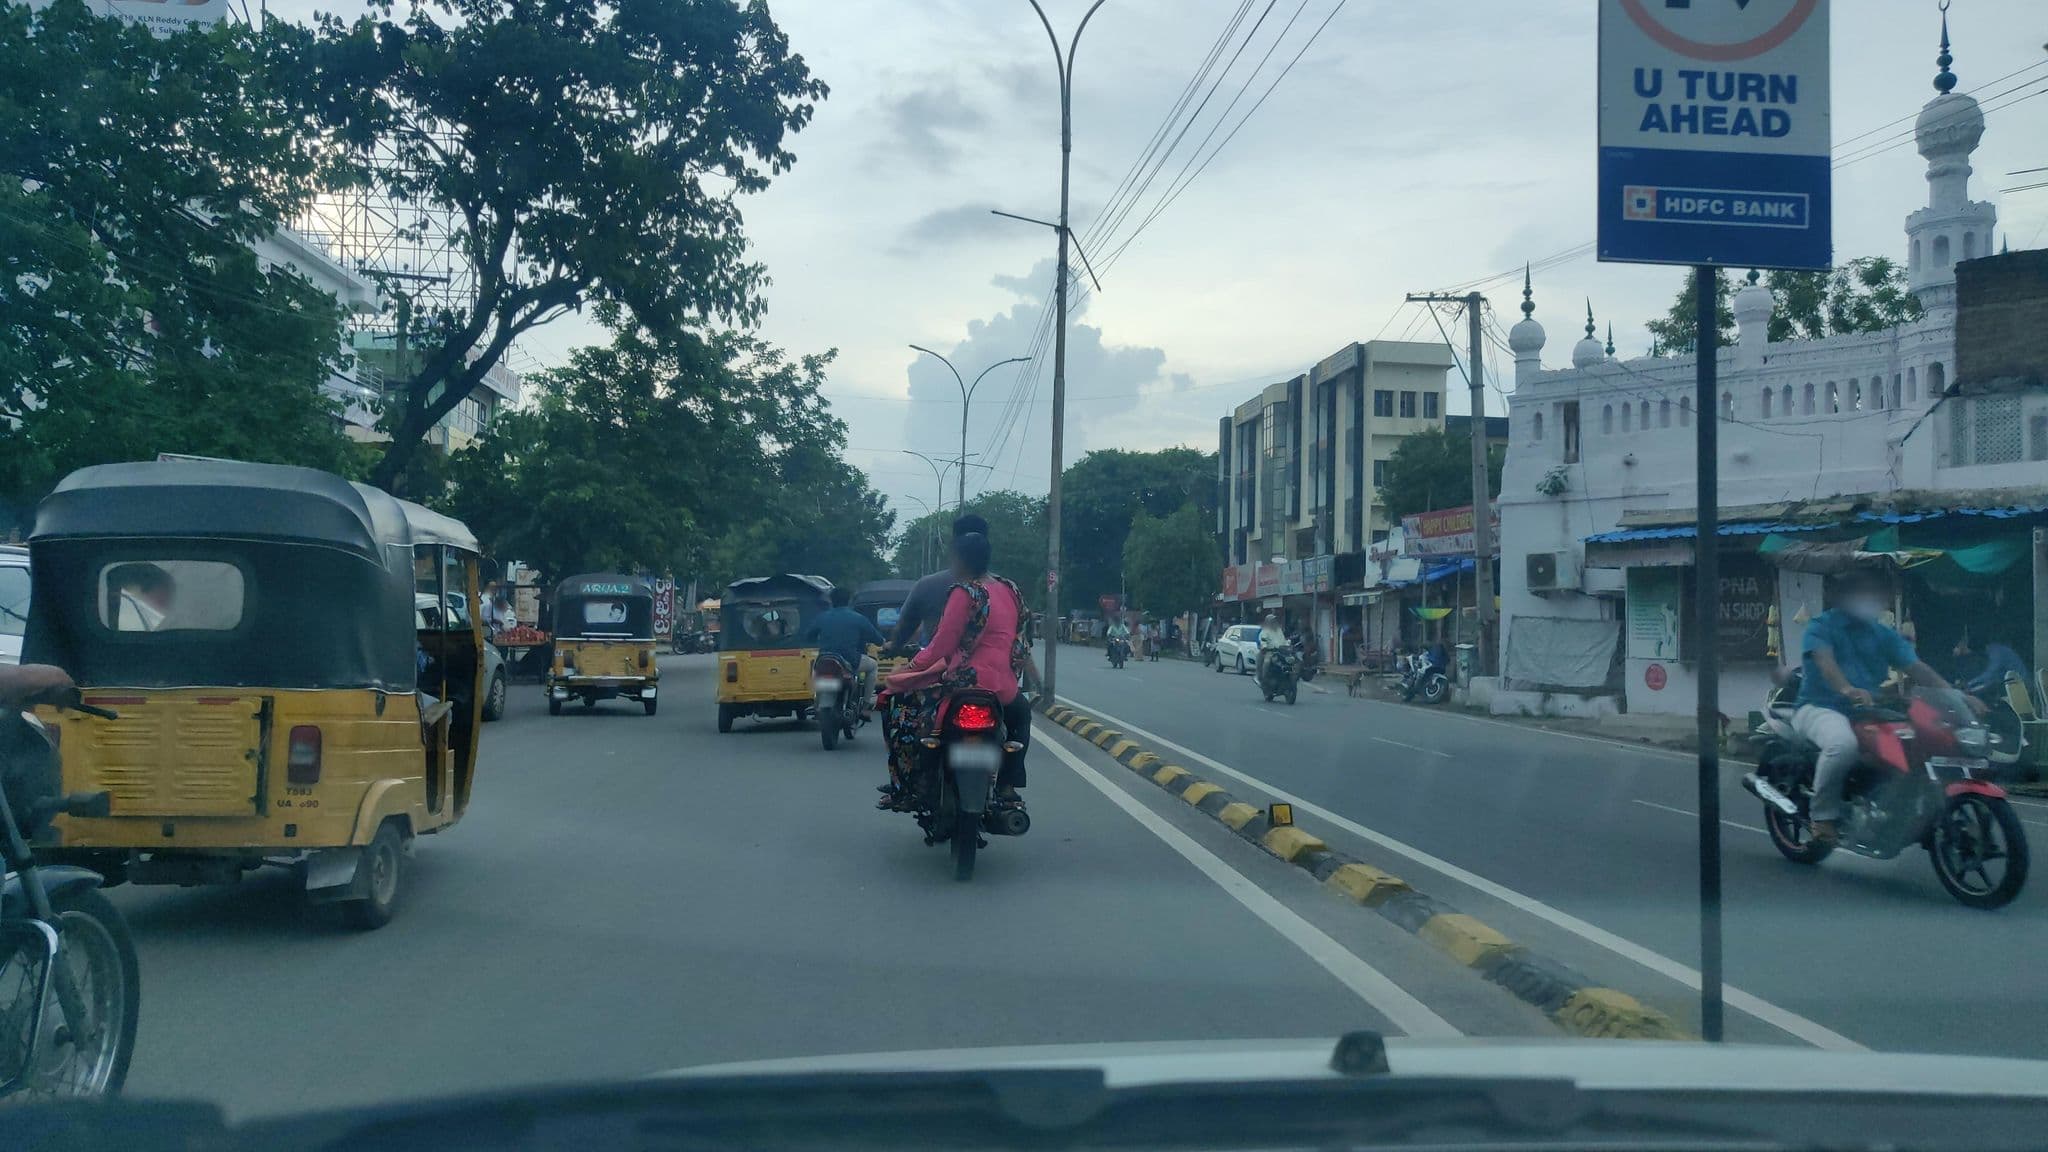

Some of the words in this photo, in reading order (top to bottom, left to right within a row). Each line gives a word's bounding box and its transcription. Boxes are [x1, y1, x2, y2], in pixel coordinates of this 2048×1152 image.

[156, 16, 181, 25] Reddy
[1633, 68, 1663, 98] U
[1678, 70, 1798, 104] TURN
[1639, 103, 1792, 138] AHEAD
[1665, 196, 1725, 215] HDFC
[1733, 199, 1796, 219] BANK
[1732, 602, 1765, 621] SHOP
